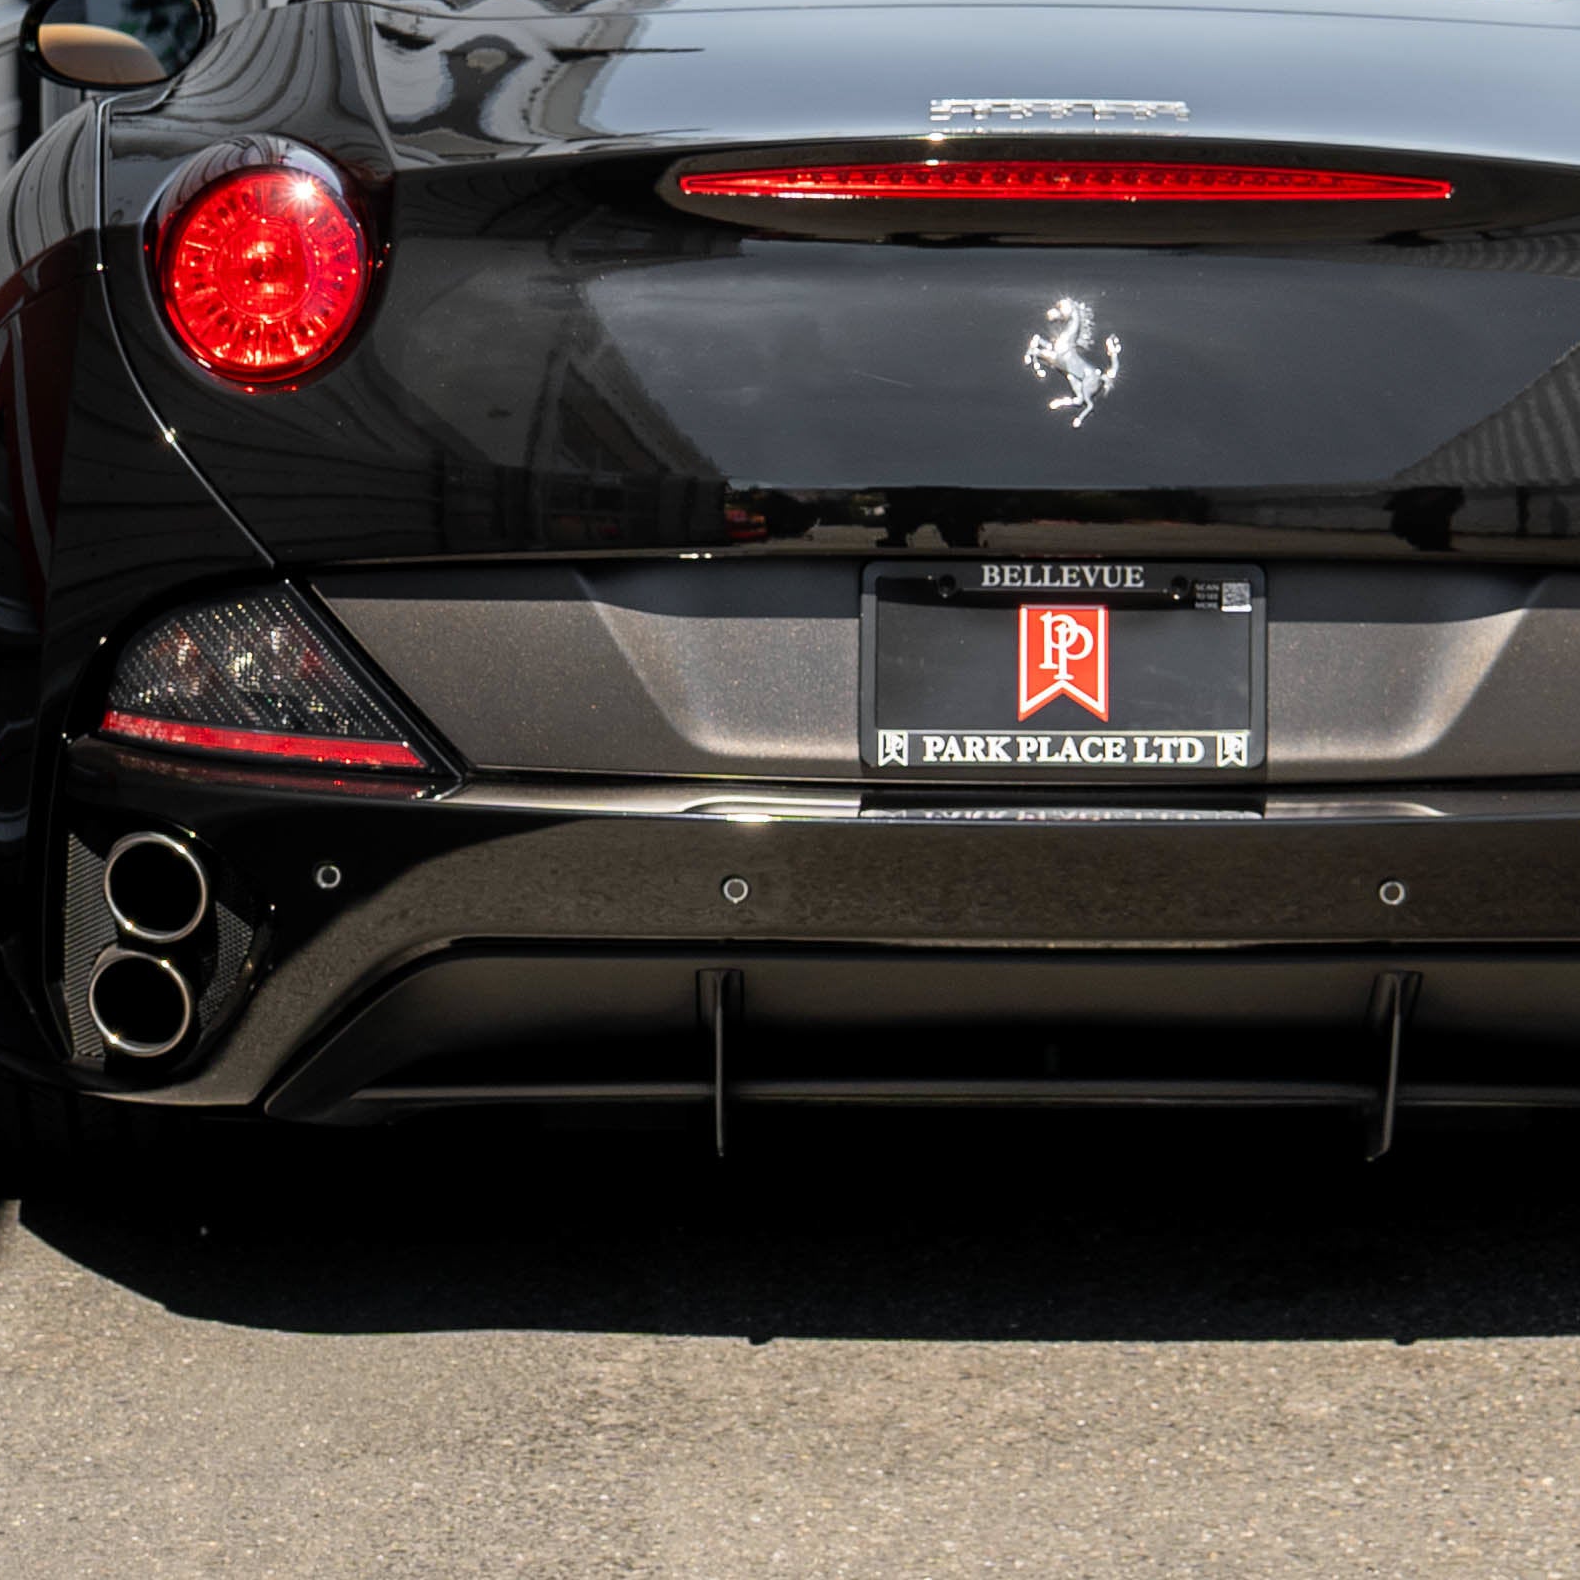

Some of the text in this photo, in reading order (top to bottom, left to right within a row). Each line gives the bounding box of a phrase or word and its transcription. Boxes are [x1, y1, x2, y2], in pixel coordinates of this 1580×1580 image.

[981, 564, 1145, 589] BELLEVUE
[922, 735, 1206, 764] PARK PLACE LTD
